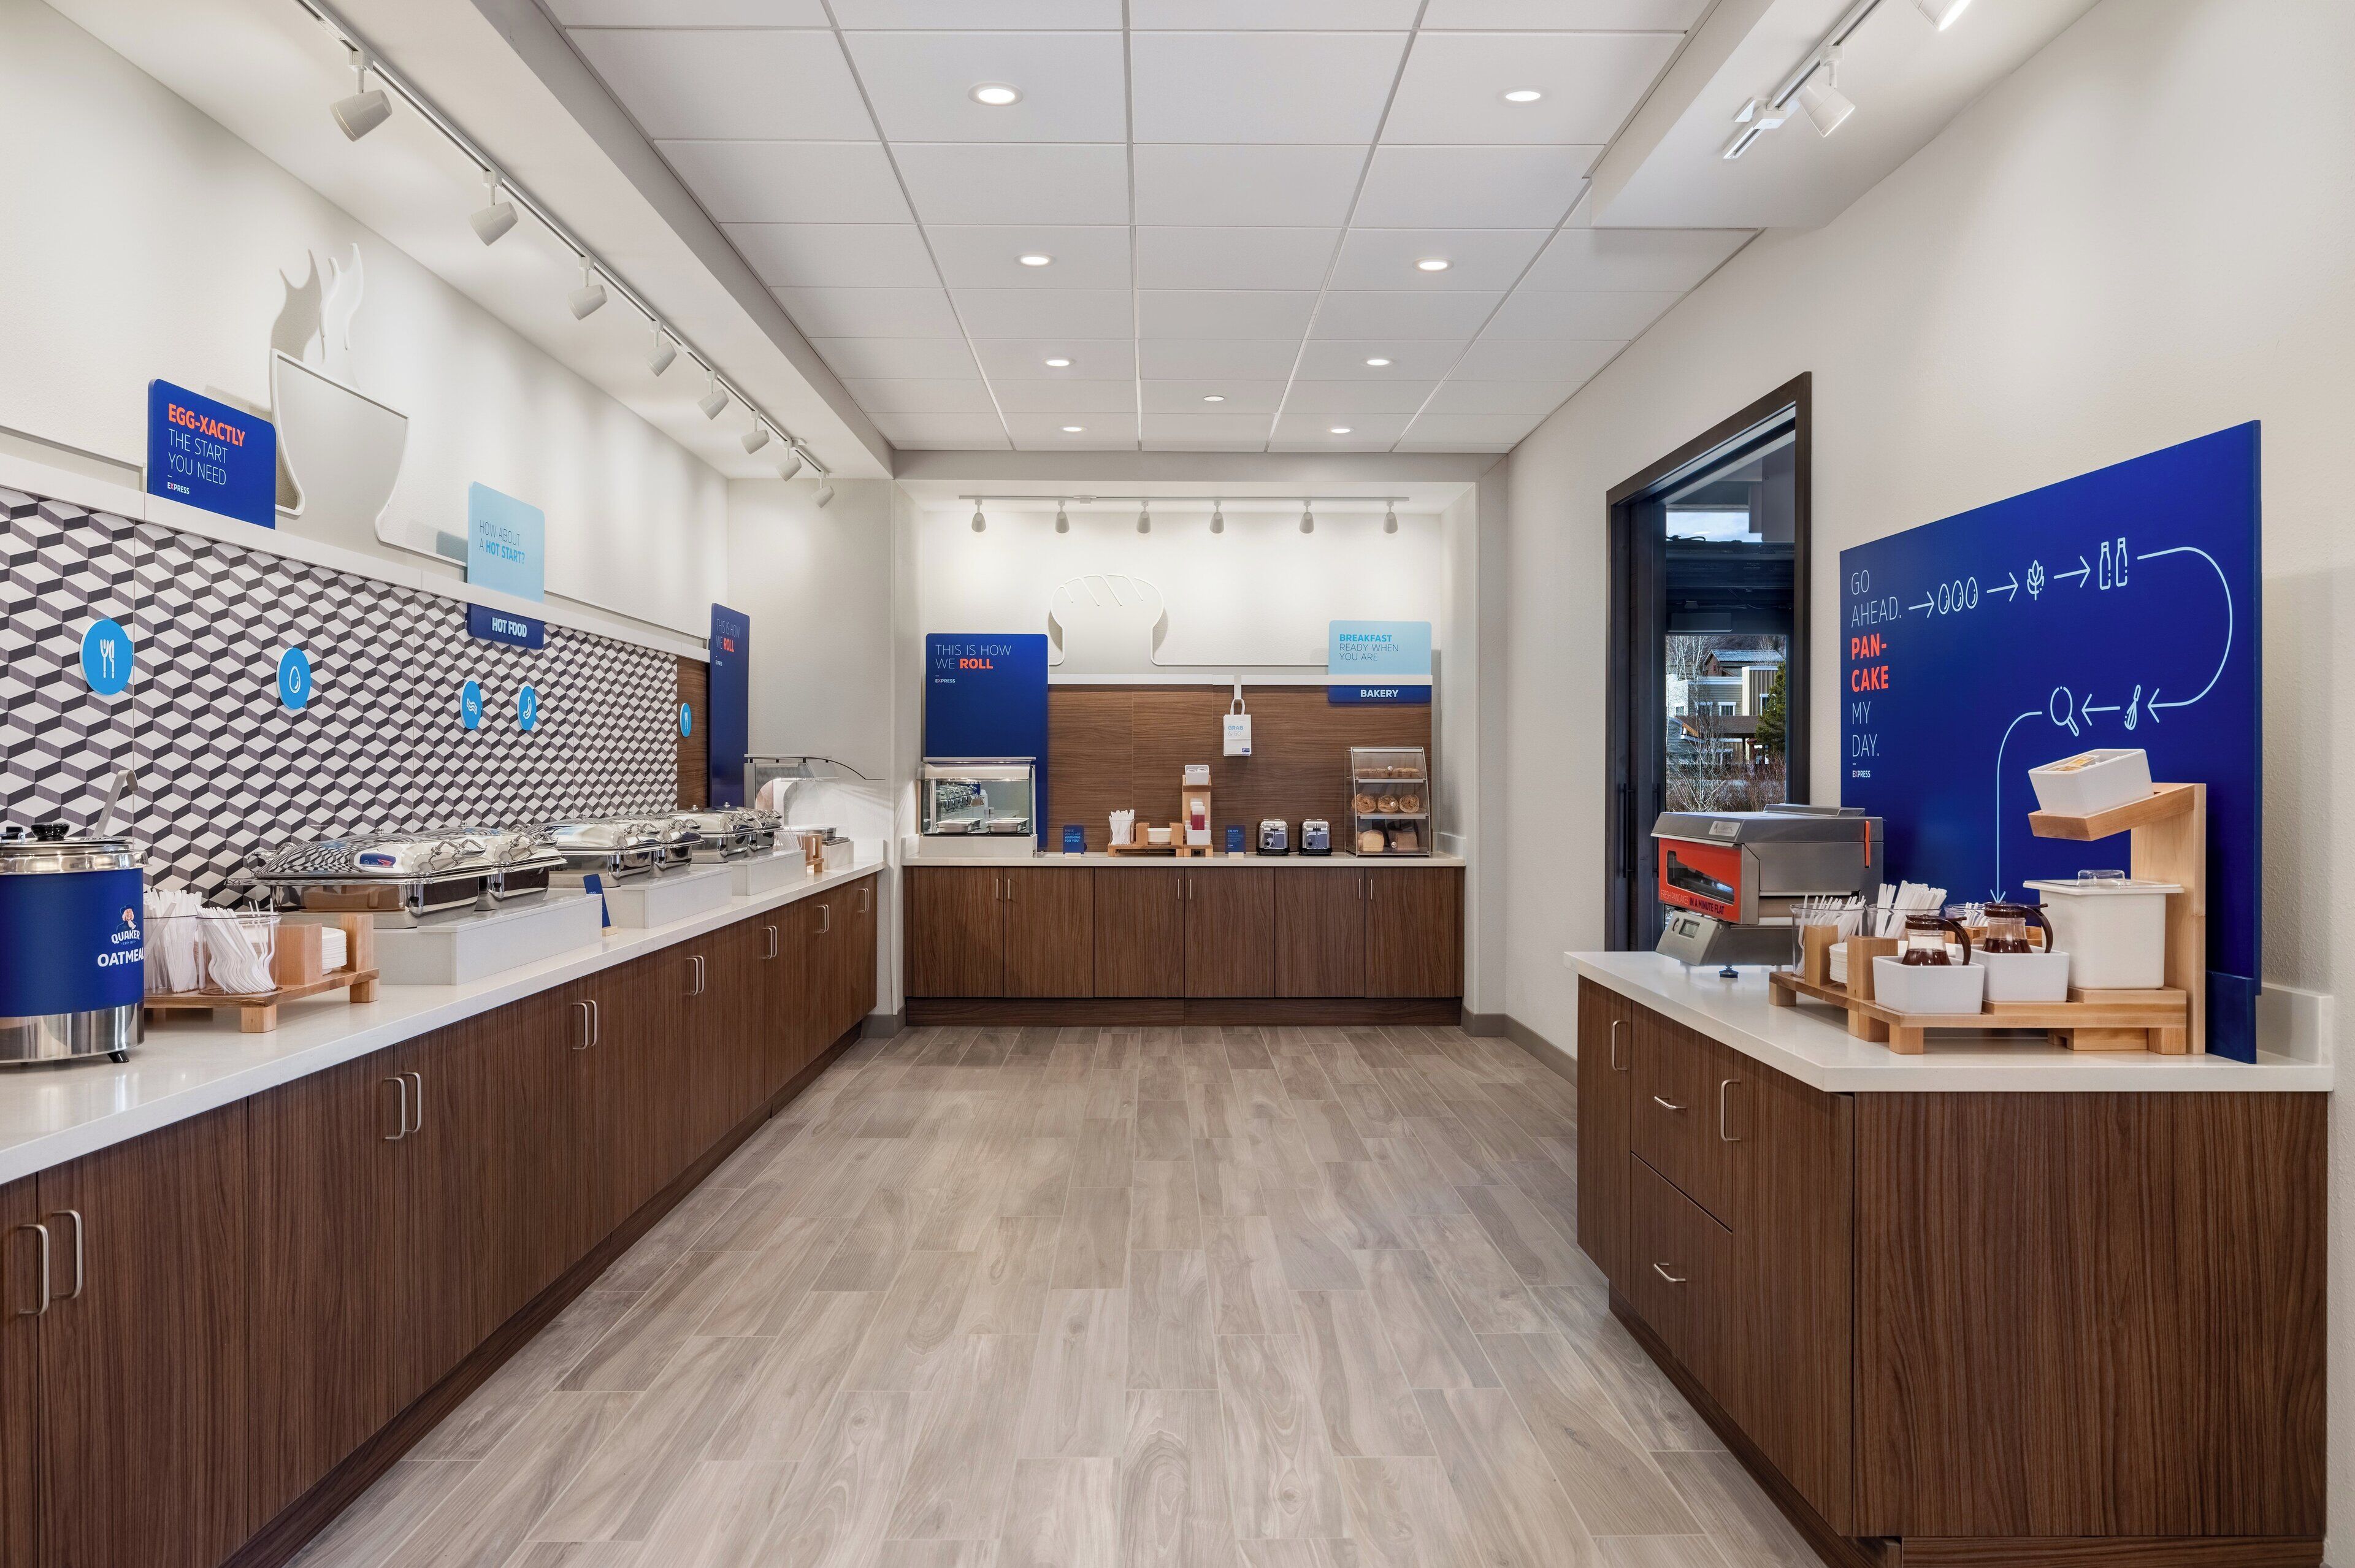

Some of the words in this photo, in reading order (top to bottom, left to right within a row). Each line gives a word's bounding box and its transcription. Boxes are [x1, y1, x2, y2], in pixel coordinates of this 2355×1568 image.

[168, 403, 245, 447] EGG-XACTLY
[168, 428, 191, 452] THE
[194, 438, 228, 464] START
[168, 451, 193, 475] YOU
[197, 461, 226, 485] NEED
[167, 481, 190, 495] EXPRESS
[480, 519, 497, 538] HOW
[498, 527, 521, 546] ABOUT
[479, 538, 484, 551] A
[486, 540, 500, 557] HOT
[502, 545, 525, 564] START?
[1851, 570, 1870, 595] GO
[1851, 596, 1902, 629] AHEAD.
[491, 617, 507, 633] HOT
[508, 621, 527, 638] FOOD
[716, 618, 725, 633] THIS
[726, 621, 730, 635] IS
[730, 624, 740, 638] HOW
[716, 635, 723, 649] WE
[724, 637, 735, 652] ROLL
[935, 644, 962, 656] THIS
[967, 644, 976, 656] IS
[981, 644, 1012, 656] HOW
[1851, 633, 1887, 660] PAN-
[935, 658, 955, 669] WE
[959, 658, 994, 669] ROLL
[1851, 665, 1889, 692] CAKE
[1360, 689, 1399, 698] BAKERY
[1852, 701, 1871, 725] MY
[1852, 733, 1879, 757] DAY.
[1661, 889, 1671, 900] FRESH
[1671, 892, 1689, 905] PANCAKES
[1690, 897, 1694, 906] IN
[1694, 899, 1698, 908] A
[1698, 900, 1714, 912] MINUTE
[1714, 904, 1725, 915] FLAT
[111, 930, 140, 944] QUAKER
[97, 947, 144, 967] OATMEAL
